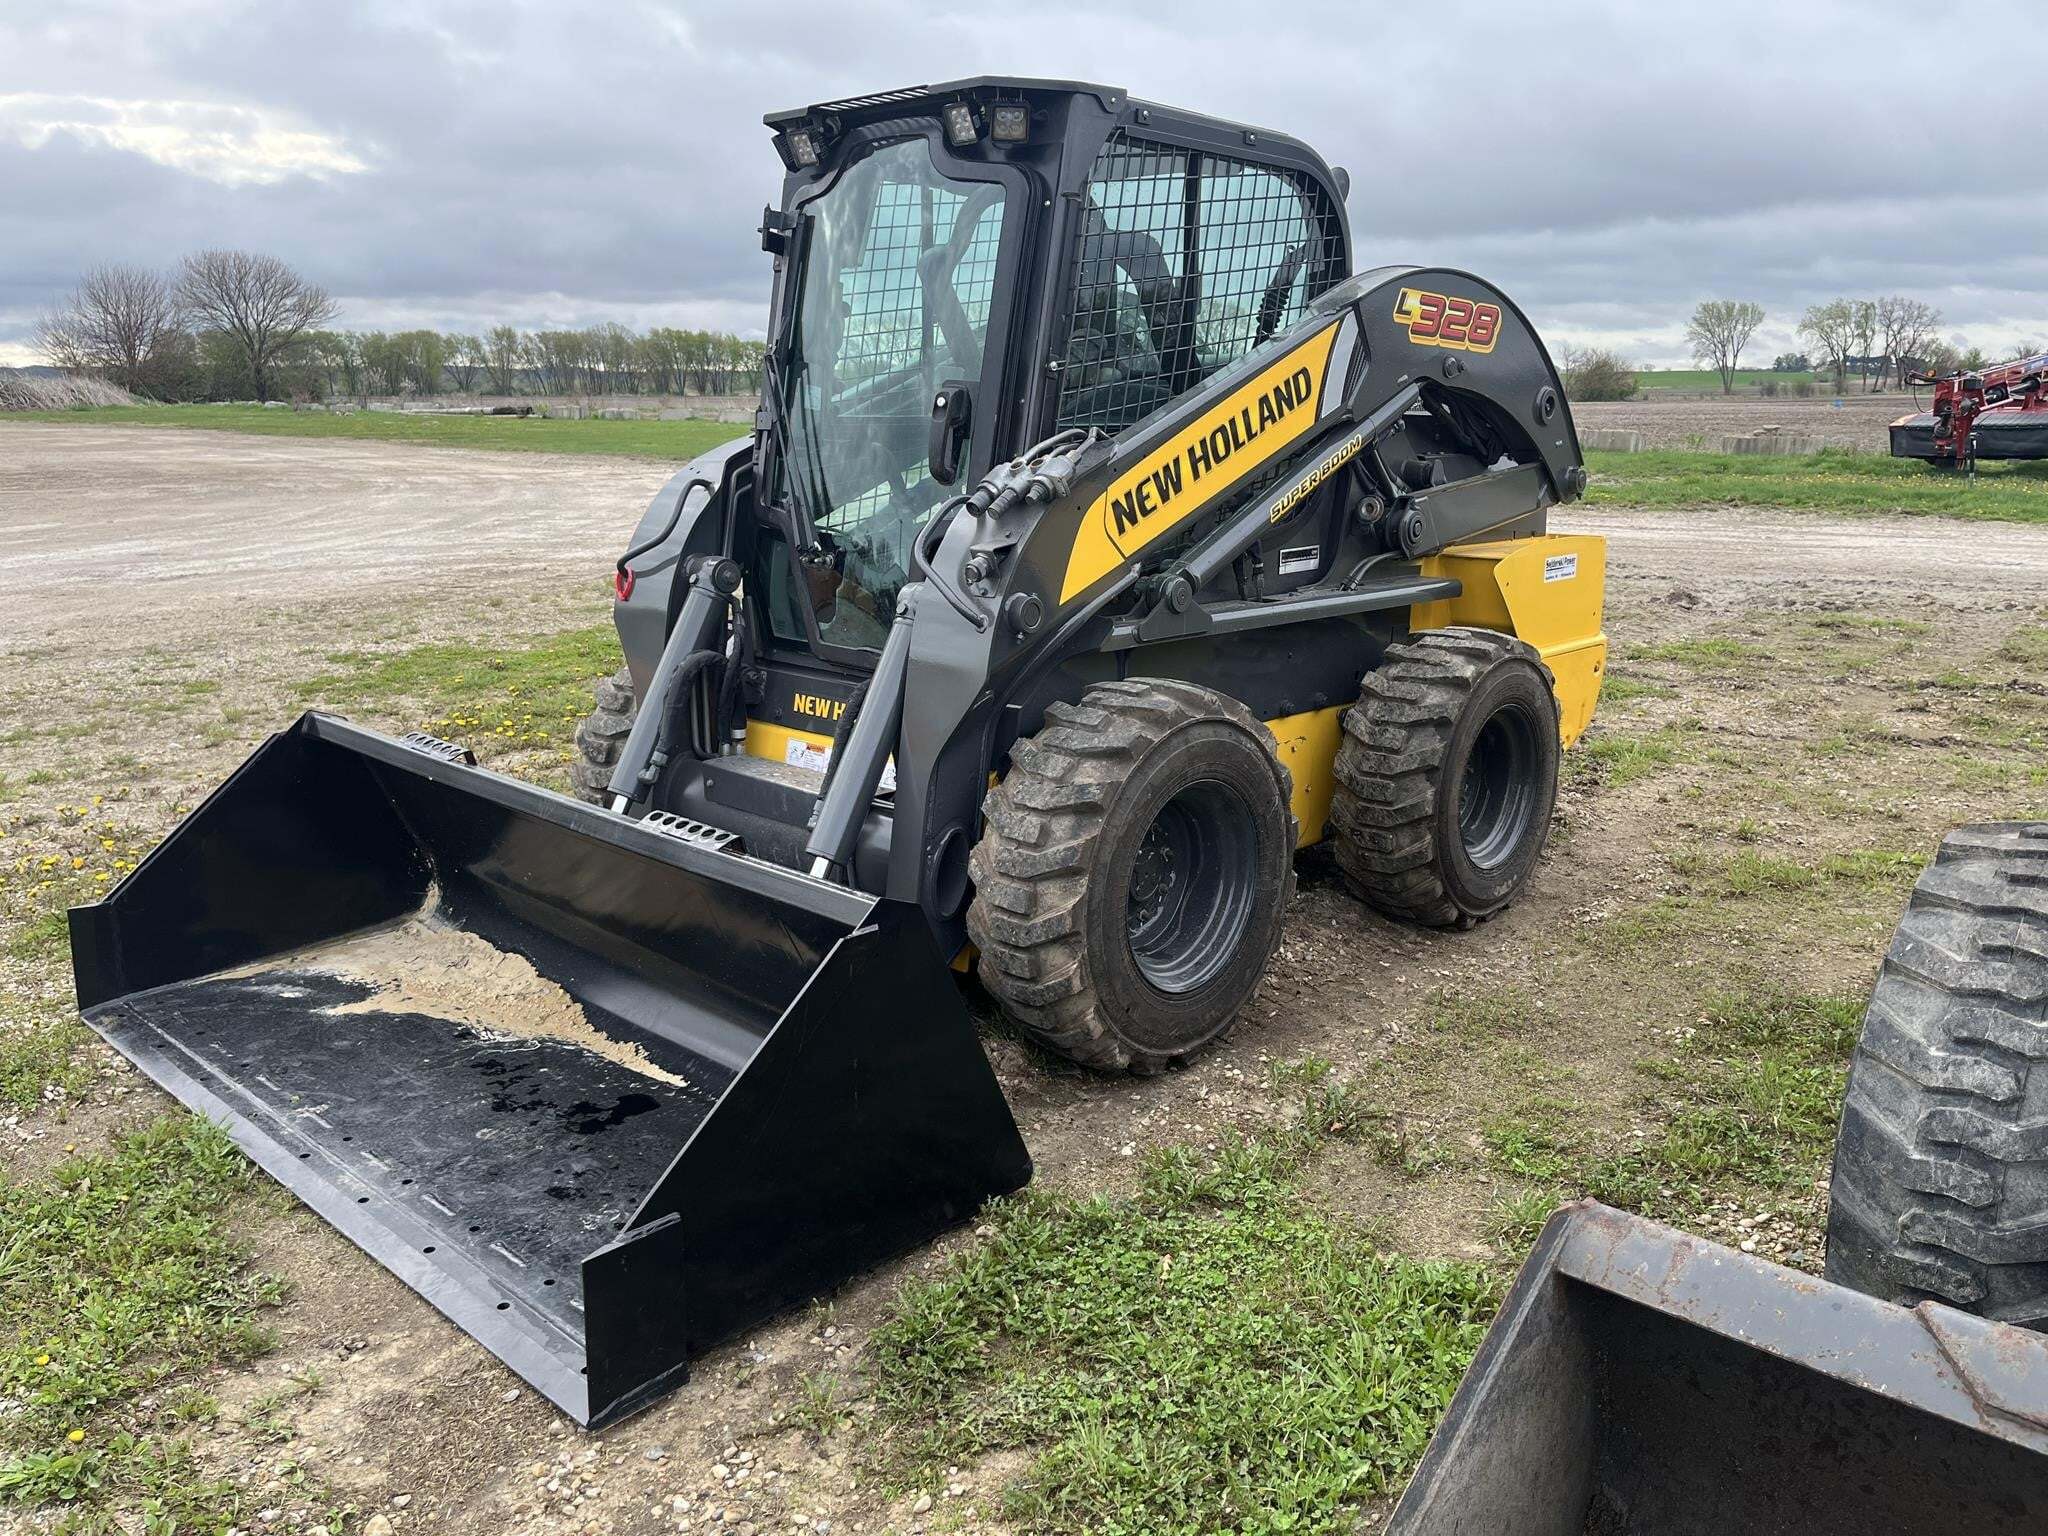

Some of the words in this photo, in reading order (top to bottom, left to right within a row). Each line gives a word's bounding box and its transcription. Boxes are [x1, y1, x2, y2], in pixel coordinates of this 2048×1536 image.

[1394, 287, 1503, 354] L328
[1110, 455, 1184, 537] NEW
[1187, 366, 1313, 482] HOLLAND
[1270, 470, 1320, 523] SUPER
[1320, 434, 1362, 480] BOOM
[793, 693, 831, 719] NEW
